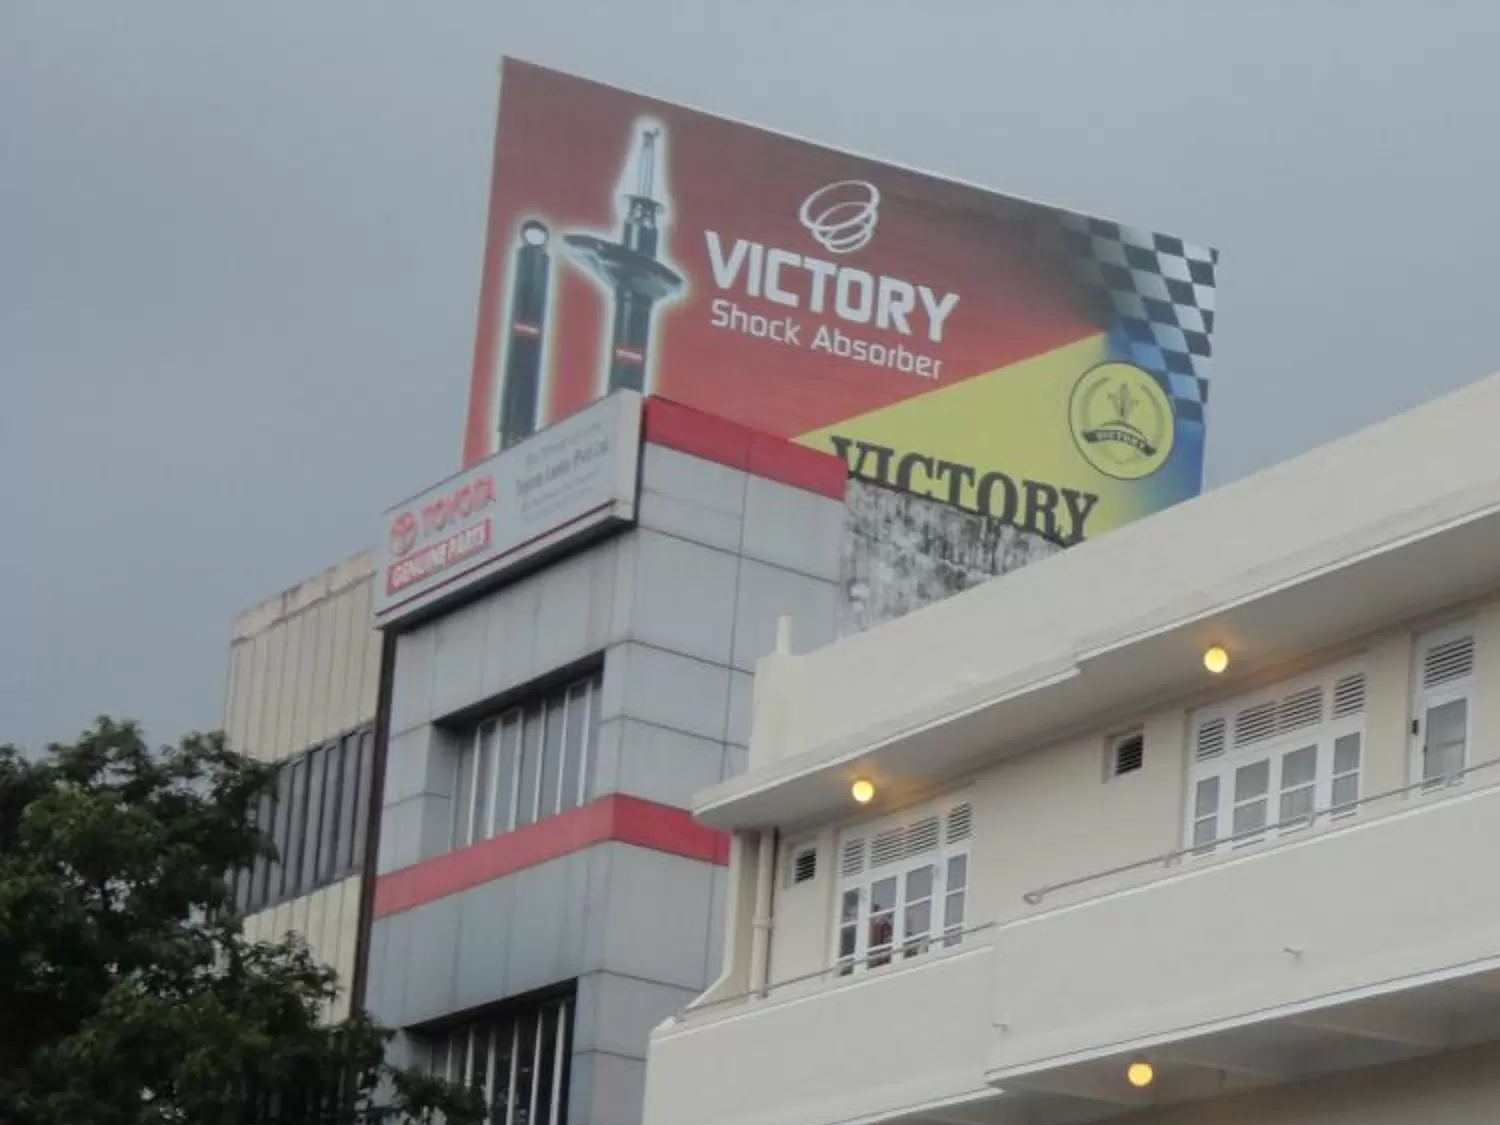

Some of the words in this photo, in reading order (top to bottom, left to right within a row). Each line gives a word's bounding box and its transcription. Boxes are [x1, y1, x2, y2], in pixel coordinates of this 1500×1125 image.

[703, 230, 961, 343] VICTORY
[710, 299, 801, 346] Shock
[811, 324, 944, 380] Absorber
[418, 475, 496, 537] TOYOTA
[831, 435, 1099, 548] VICTORY
